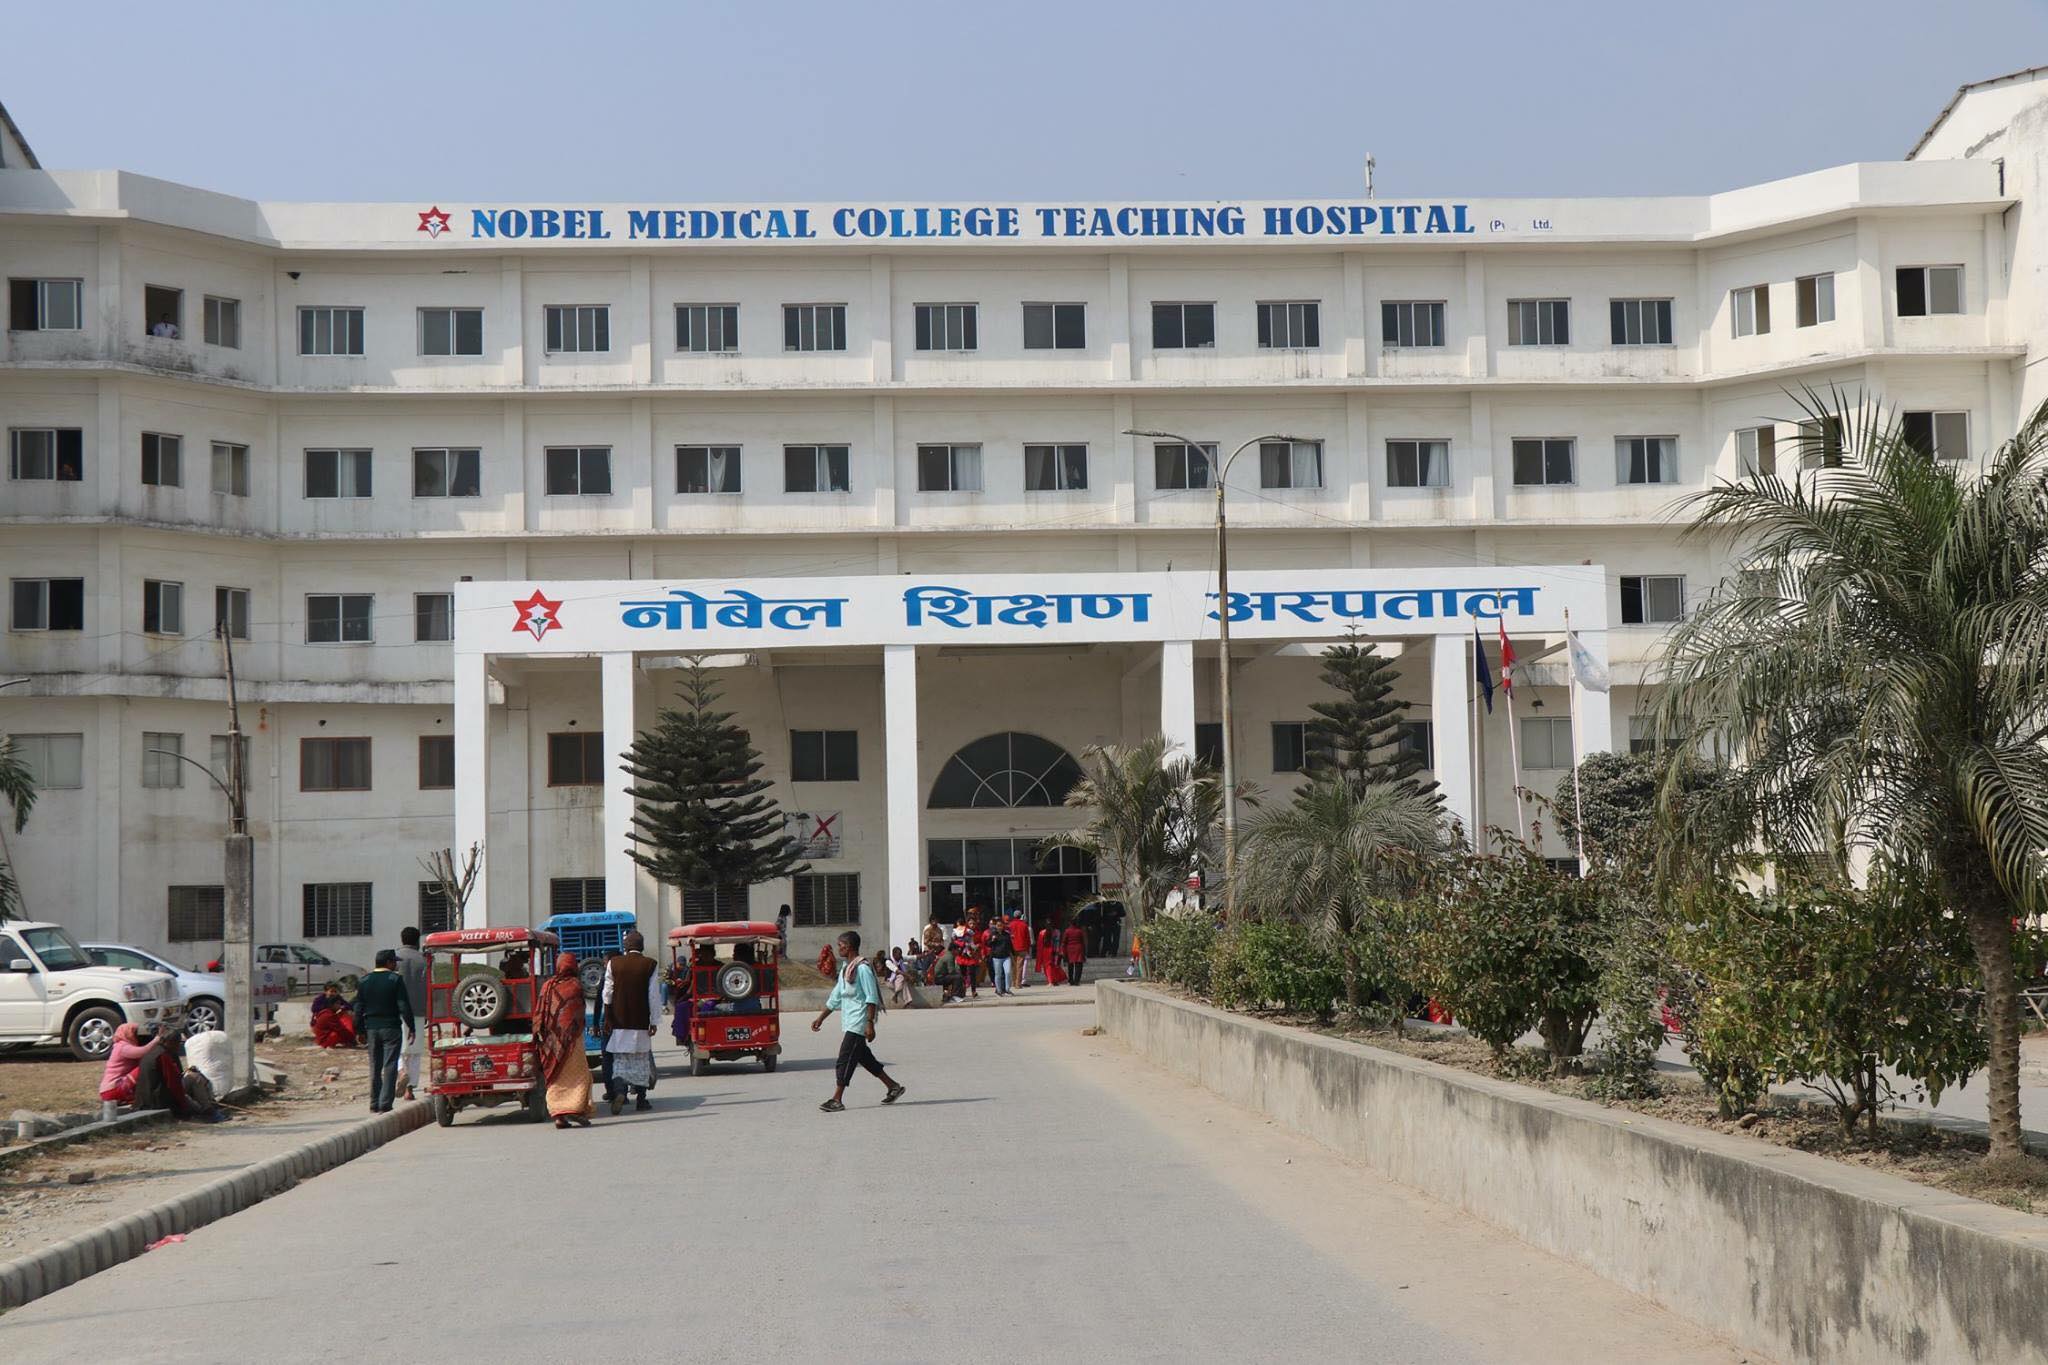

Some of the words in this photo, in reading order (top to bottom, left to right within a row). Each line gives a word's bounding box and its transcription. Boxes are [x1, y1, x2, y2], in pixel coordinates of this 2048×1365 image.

[472, 209, 610, 239] NOBEL
[628, 209, 817, 240] MEDICAL
[832, 207, 1020, 239] COLLEGE
[1036, 207, 1246, 238] TEACHING
[1263, 205, 1475, 236] HOSPITAL
[1533, 219, 1553, 230] Ltd.
[620, 588, 849, 631] नोबेल
[902, 585, 1153, 629] शिक्षण
[1205, 587, 1542, 623] अस्पताल
